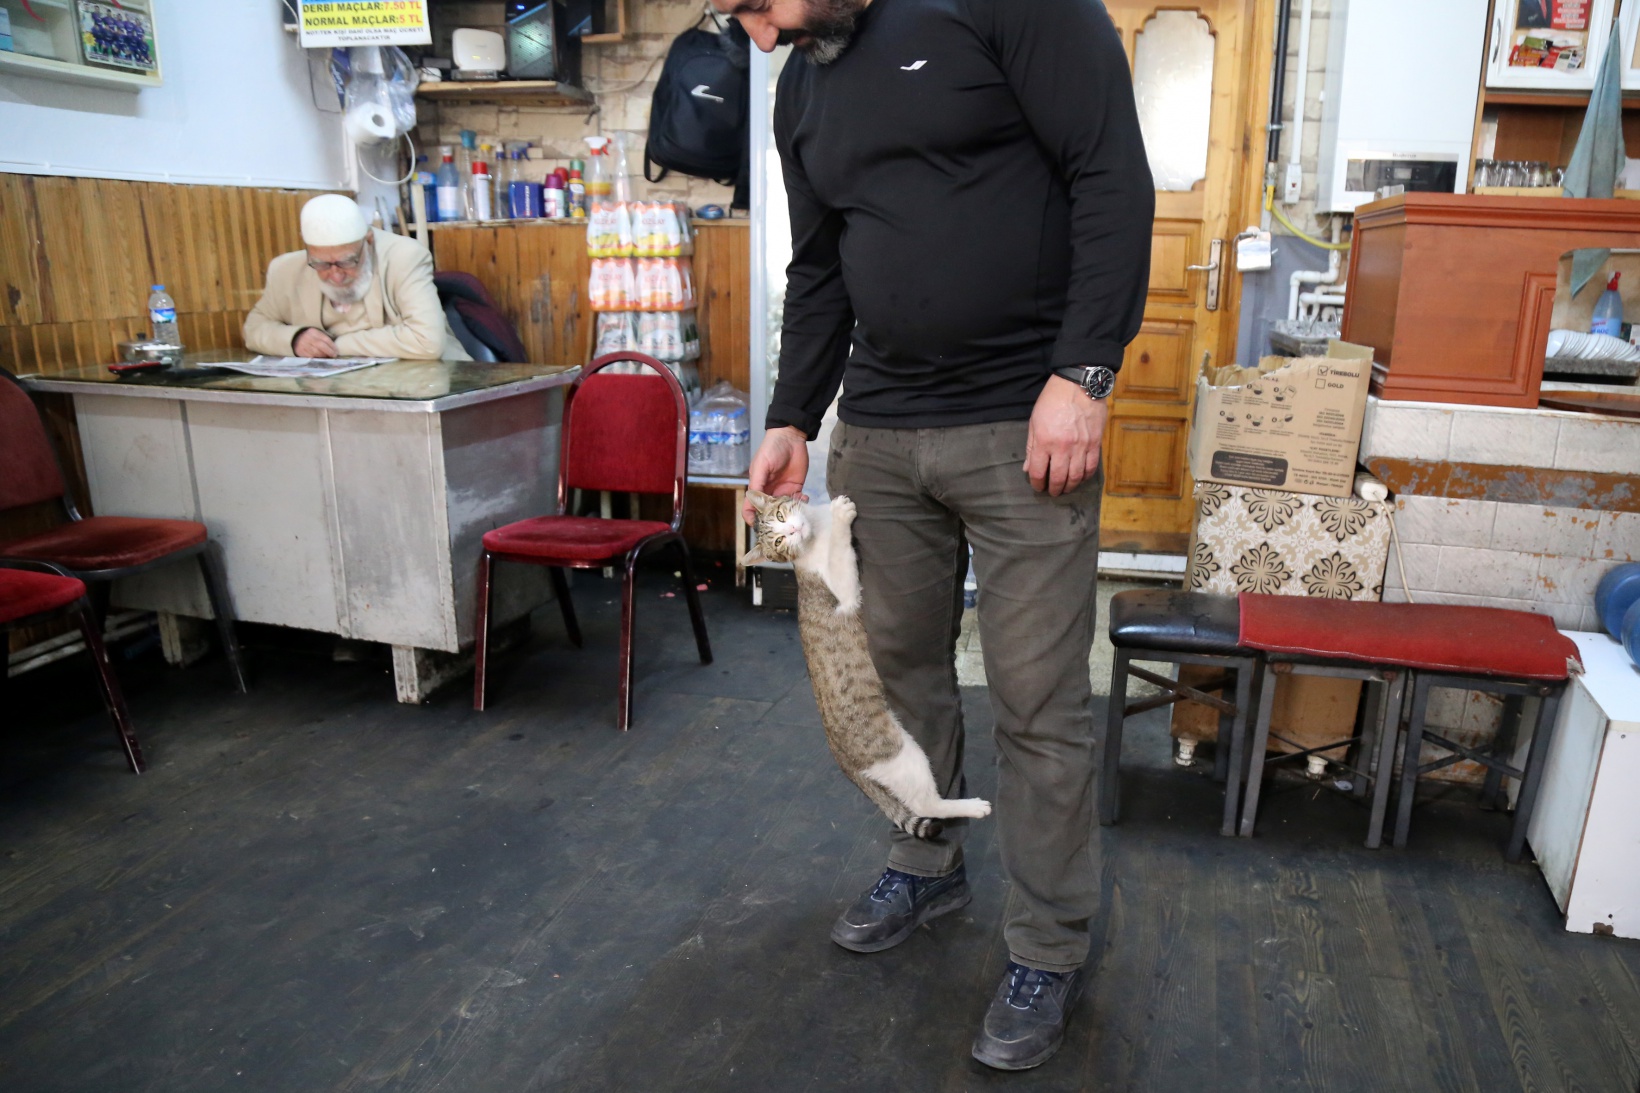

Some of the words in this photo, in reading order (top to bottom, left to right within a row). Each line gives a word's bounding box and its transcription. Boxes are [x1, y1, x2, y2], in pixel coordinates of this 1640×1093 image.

[303, 3, 334, 13] DERBİ
[409, 1, 422, 9] TL
[305, 16, 349, 26] NORMAL
[409, 14, 422, 23] TL
[1330, 369, 1360, 378] TİREBOLU
